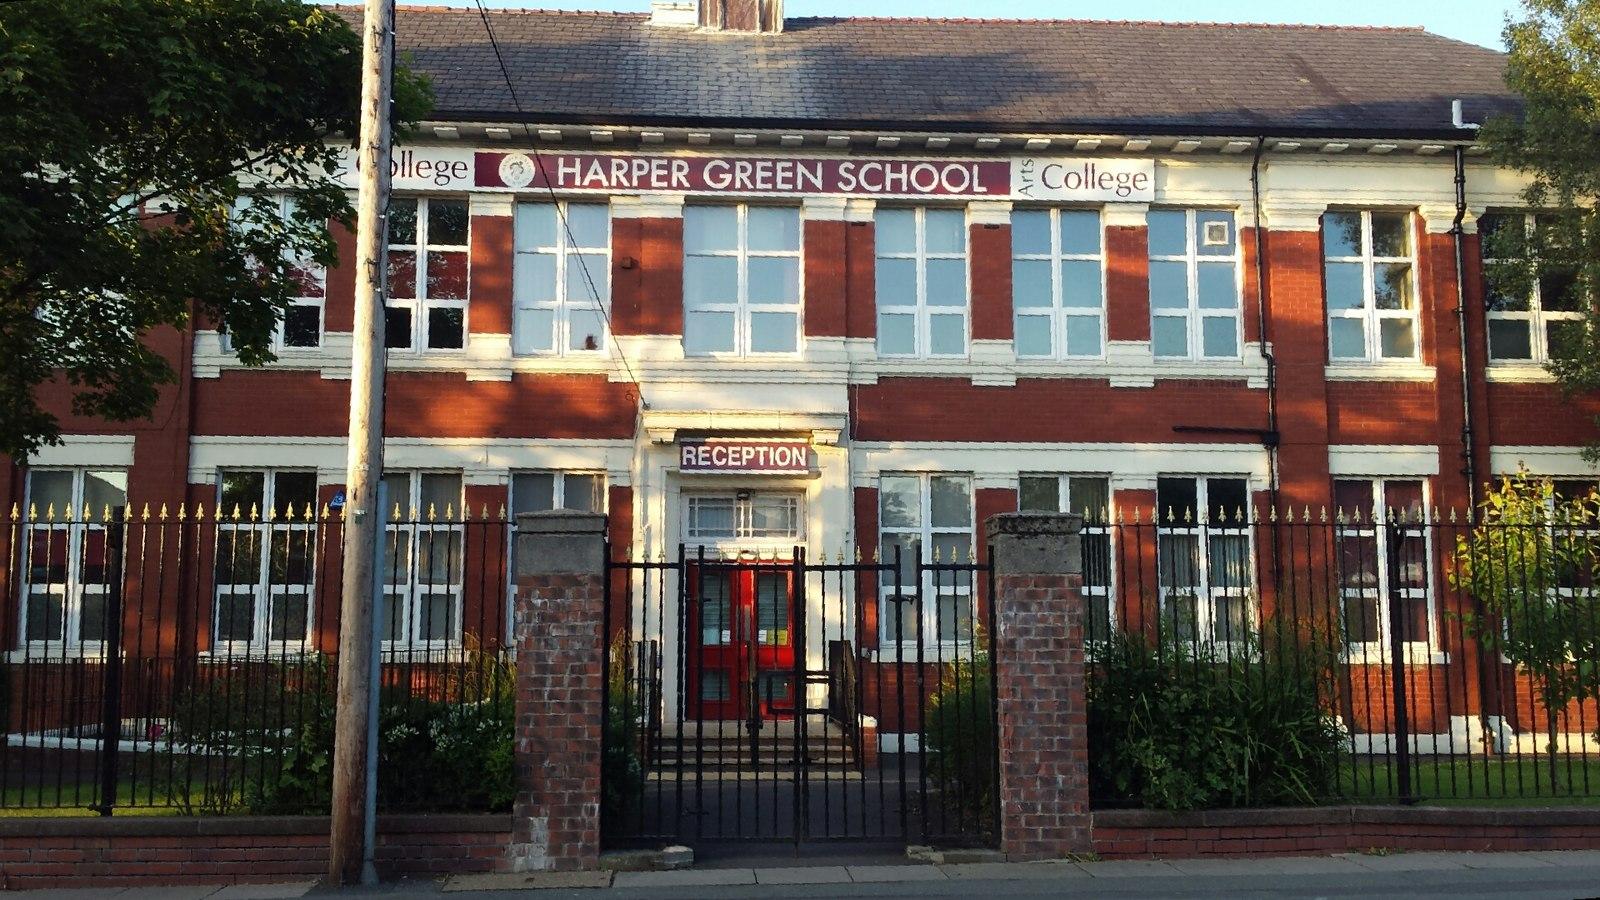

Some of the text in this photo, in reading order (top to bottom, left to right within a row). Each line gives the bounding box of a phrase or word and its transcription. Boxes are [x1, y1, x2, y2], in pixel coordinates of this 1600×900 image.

[356, 151, 468, 186] llege
[557, 157, 690, 188] HARPER
[702, 159, 824, 191] GREEN
[837, 162, 987, 193] SCHOOL
[1018, 158, 1034, 197] Arts
[1041, 162, 1148, 197] College
[682, 446, 806, 467] RECEPTION
